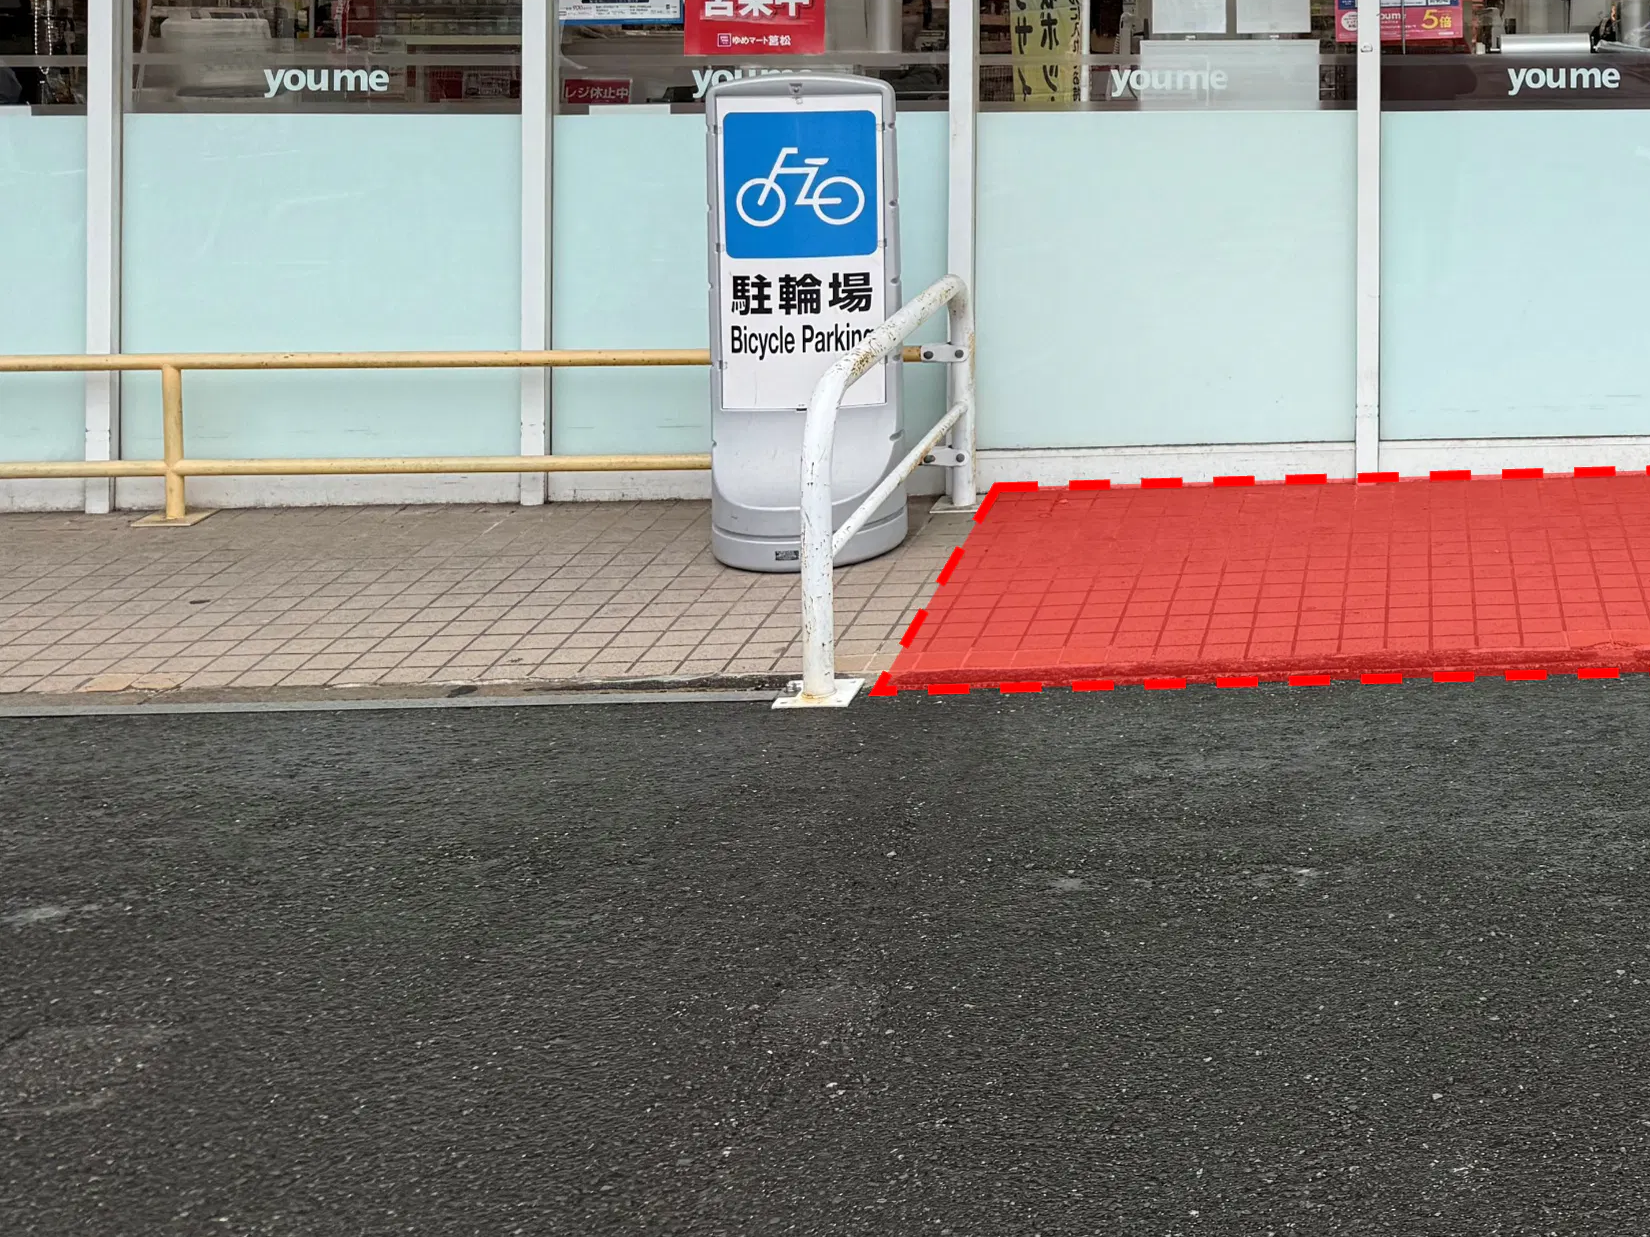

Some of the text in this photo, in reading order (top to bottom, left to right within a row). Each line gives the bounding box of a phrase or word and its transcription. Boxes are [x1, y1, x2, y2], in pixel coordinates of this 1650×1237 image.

[1421, 9, 1452, 29] 5倍
[263, 68, 390, 98] youme
[565, 86, 629, 99] レジ休止中
[1110, 69, 1228, 97] youme
[1507, 67, 1621, 96] youme
[731, 271, 873, 316] 駐輪場
[731, 322, 875, 361] Bicycle Parkin
